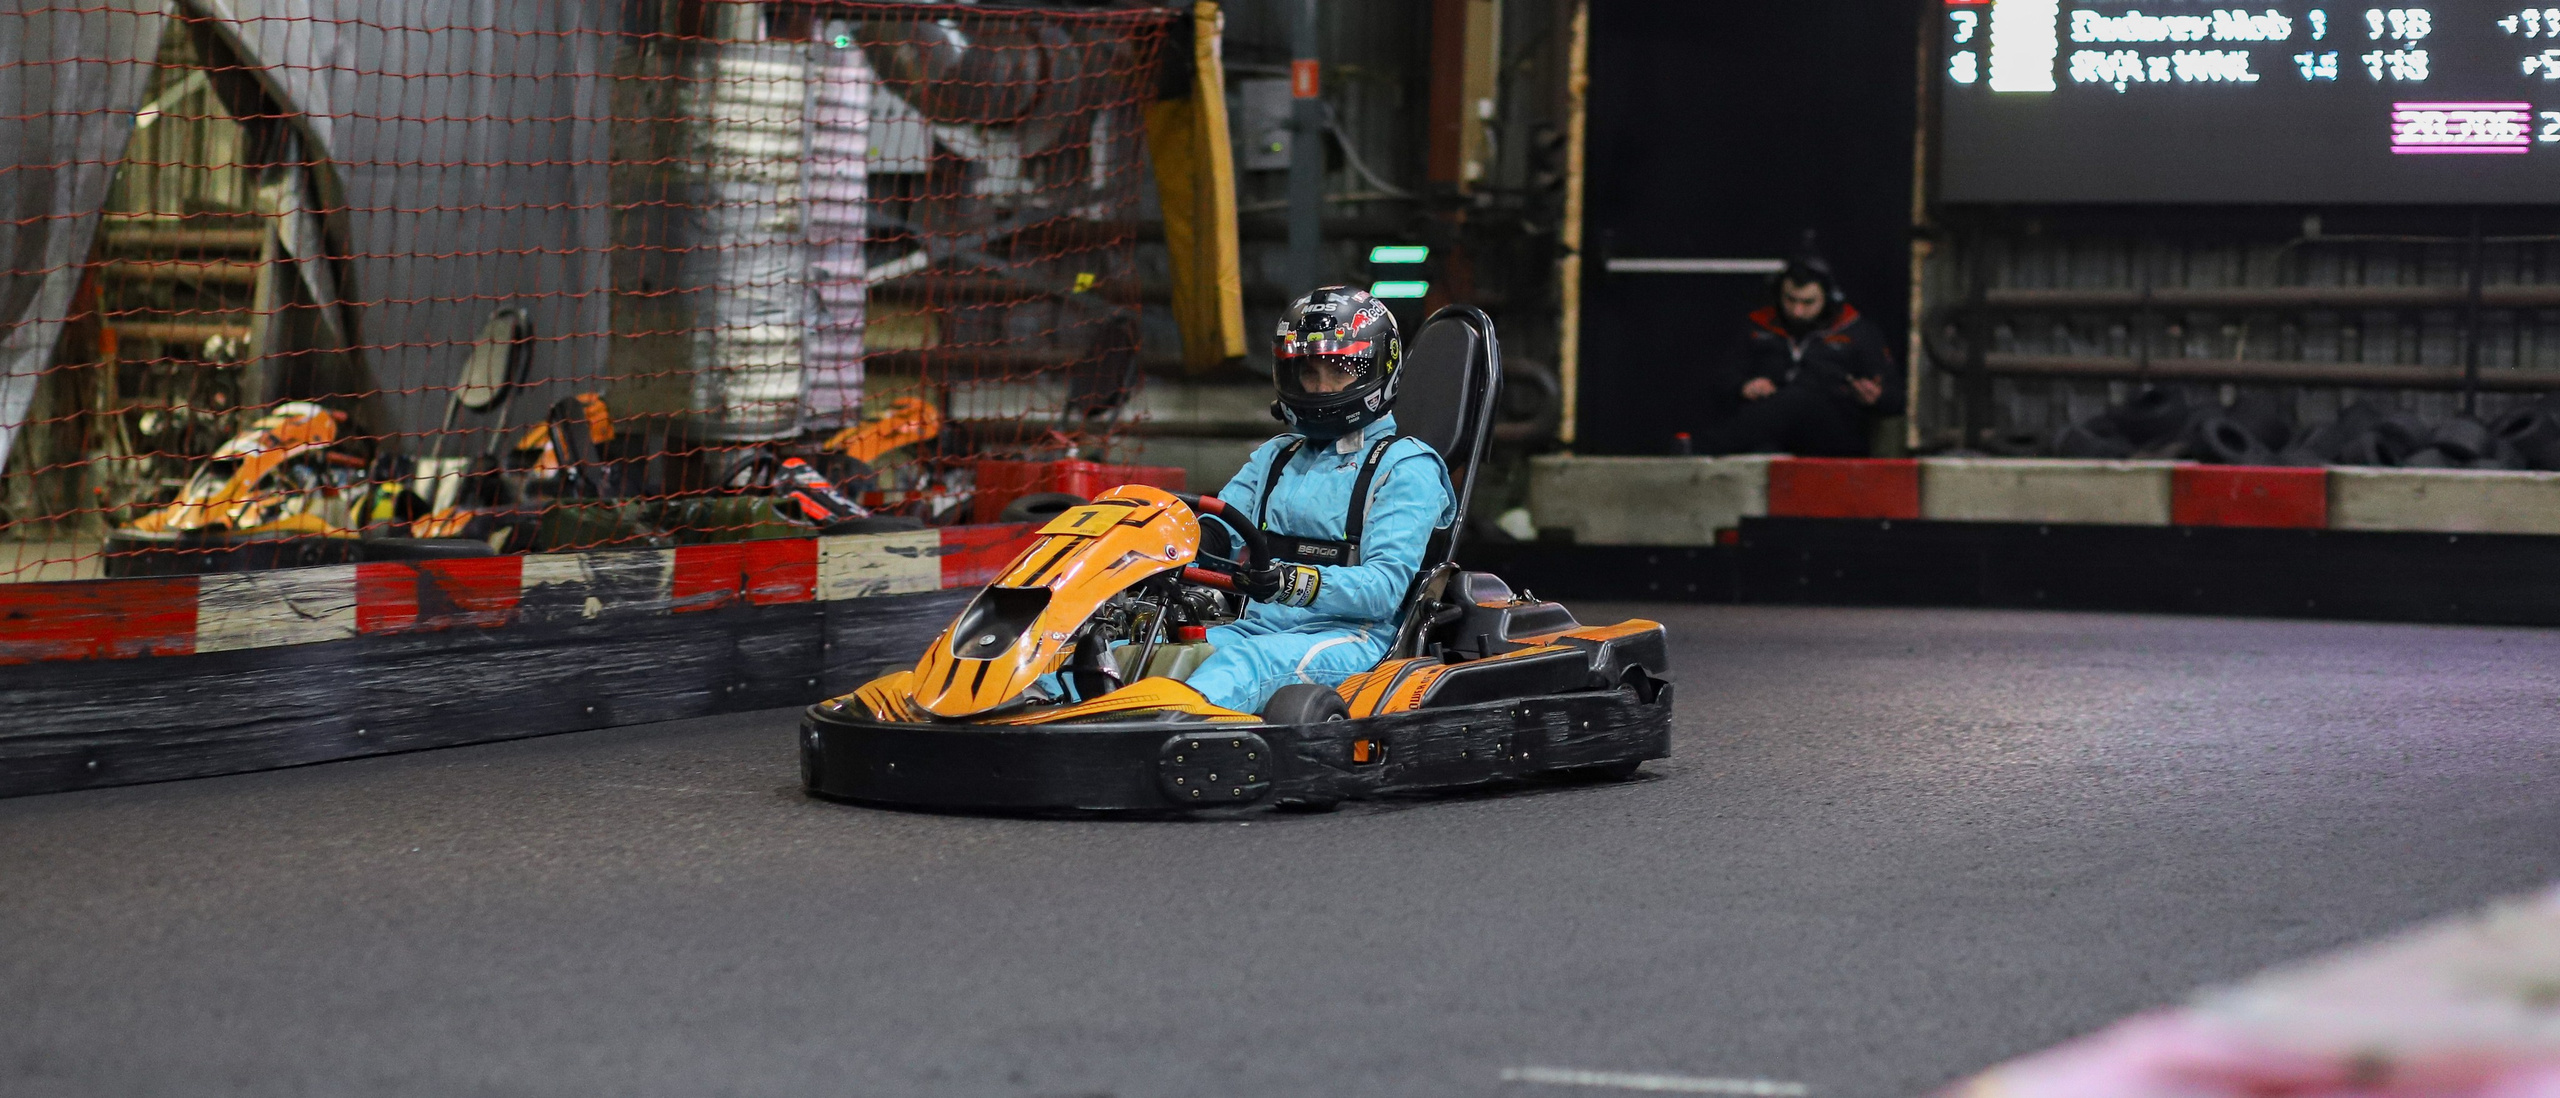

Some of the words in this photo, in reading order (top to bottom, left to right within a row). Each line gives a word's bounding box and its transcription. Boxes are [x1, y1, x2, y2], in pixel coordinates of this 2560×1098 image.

[1301, 303, 1338, 314] MDS
[1071, 511, 1099, 527] 1
[1297, 545, 1338, 556] BENGIO
[1409, 685, 1427, 712] OWER
